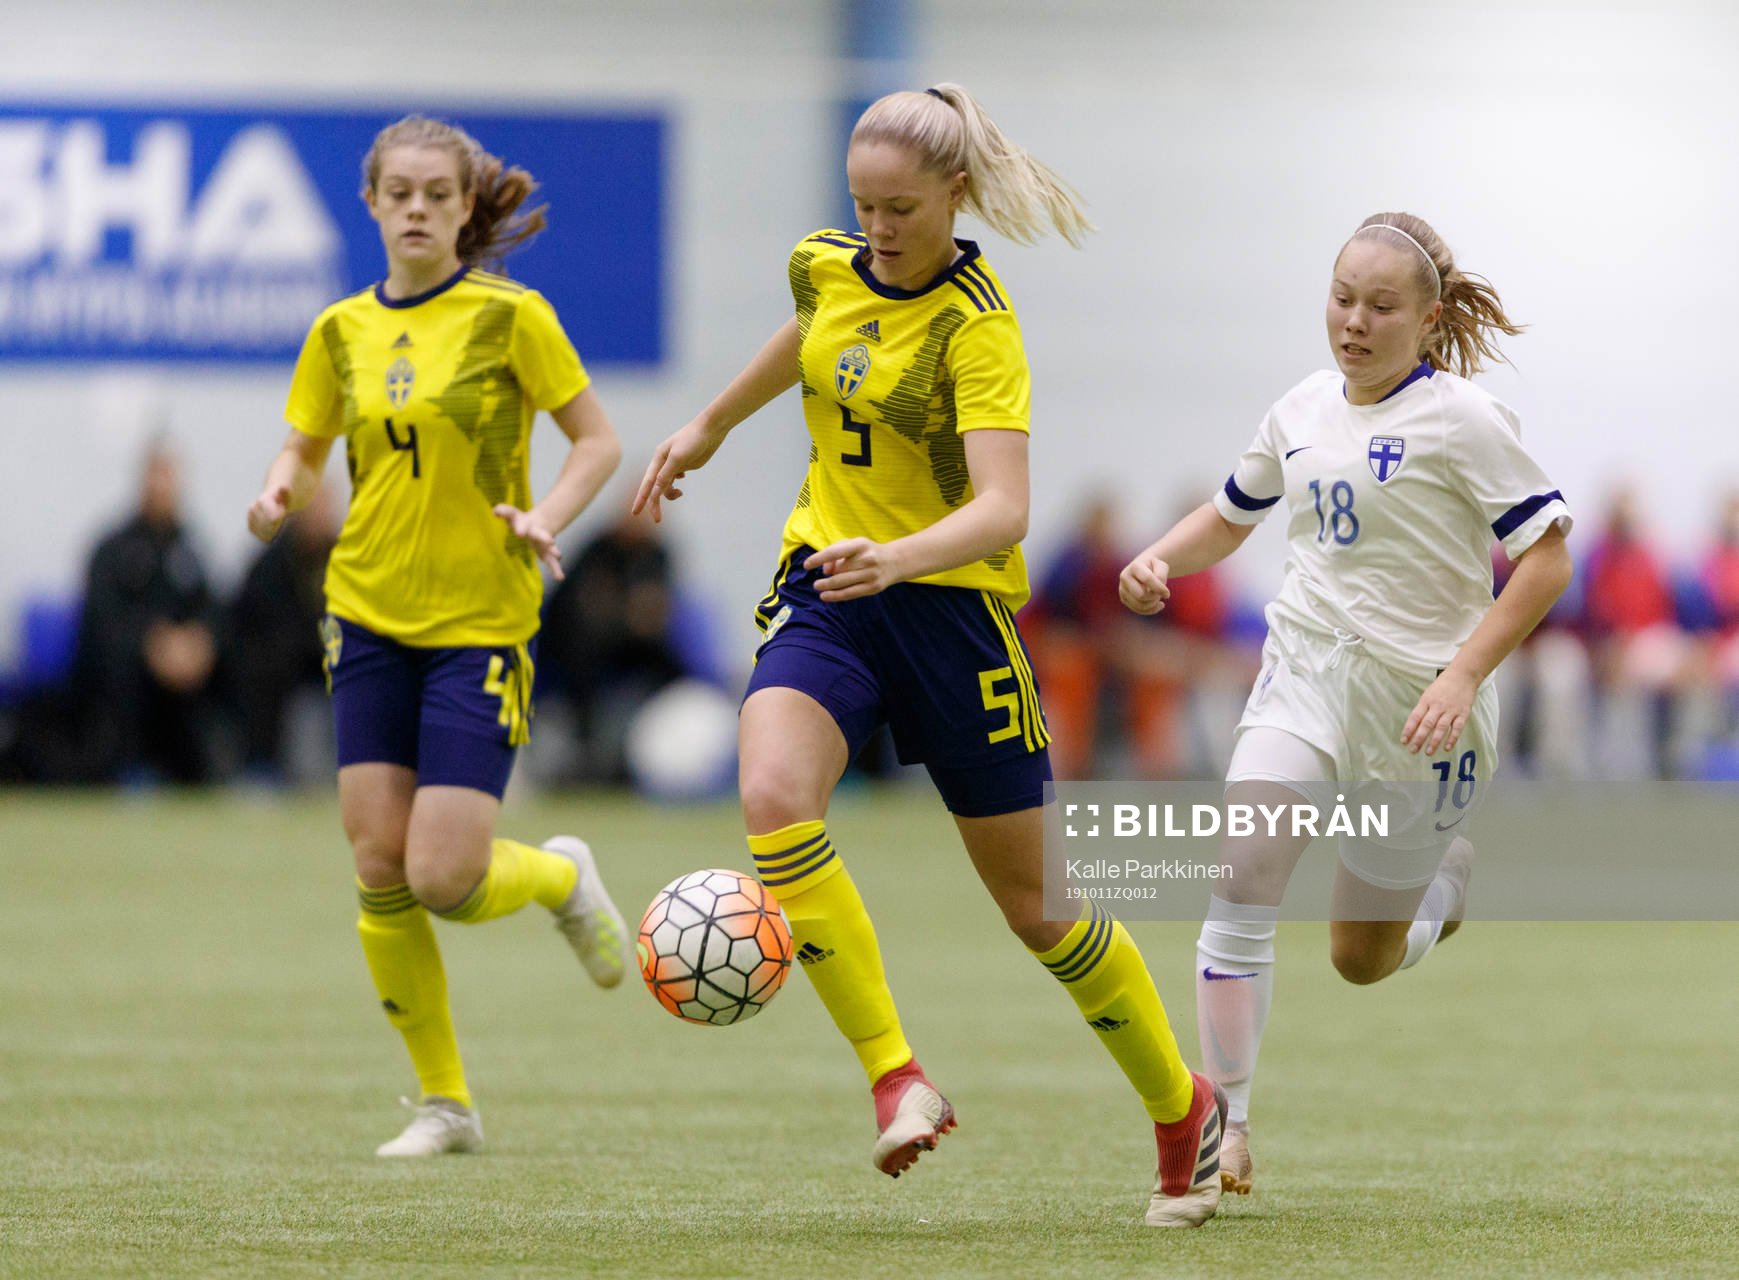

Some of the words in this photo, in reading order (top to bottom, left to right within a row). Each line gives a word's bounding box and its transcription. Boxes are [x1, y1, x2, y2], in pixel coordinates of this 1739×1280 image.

[385, 417, 421, 479] 4
[836, 402, 871, 467] 5
[1309, 479, 1360, 545] 18
[483, 655, 516, 726] 4
[978, 666, 1022, 744] 5
[1432, 750, 1476, 813] 18
